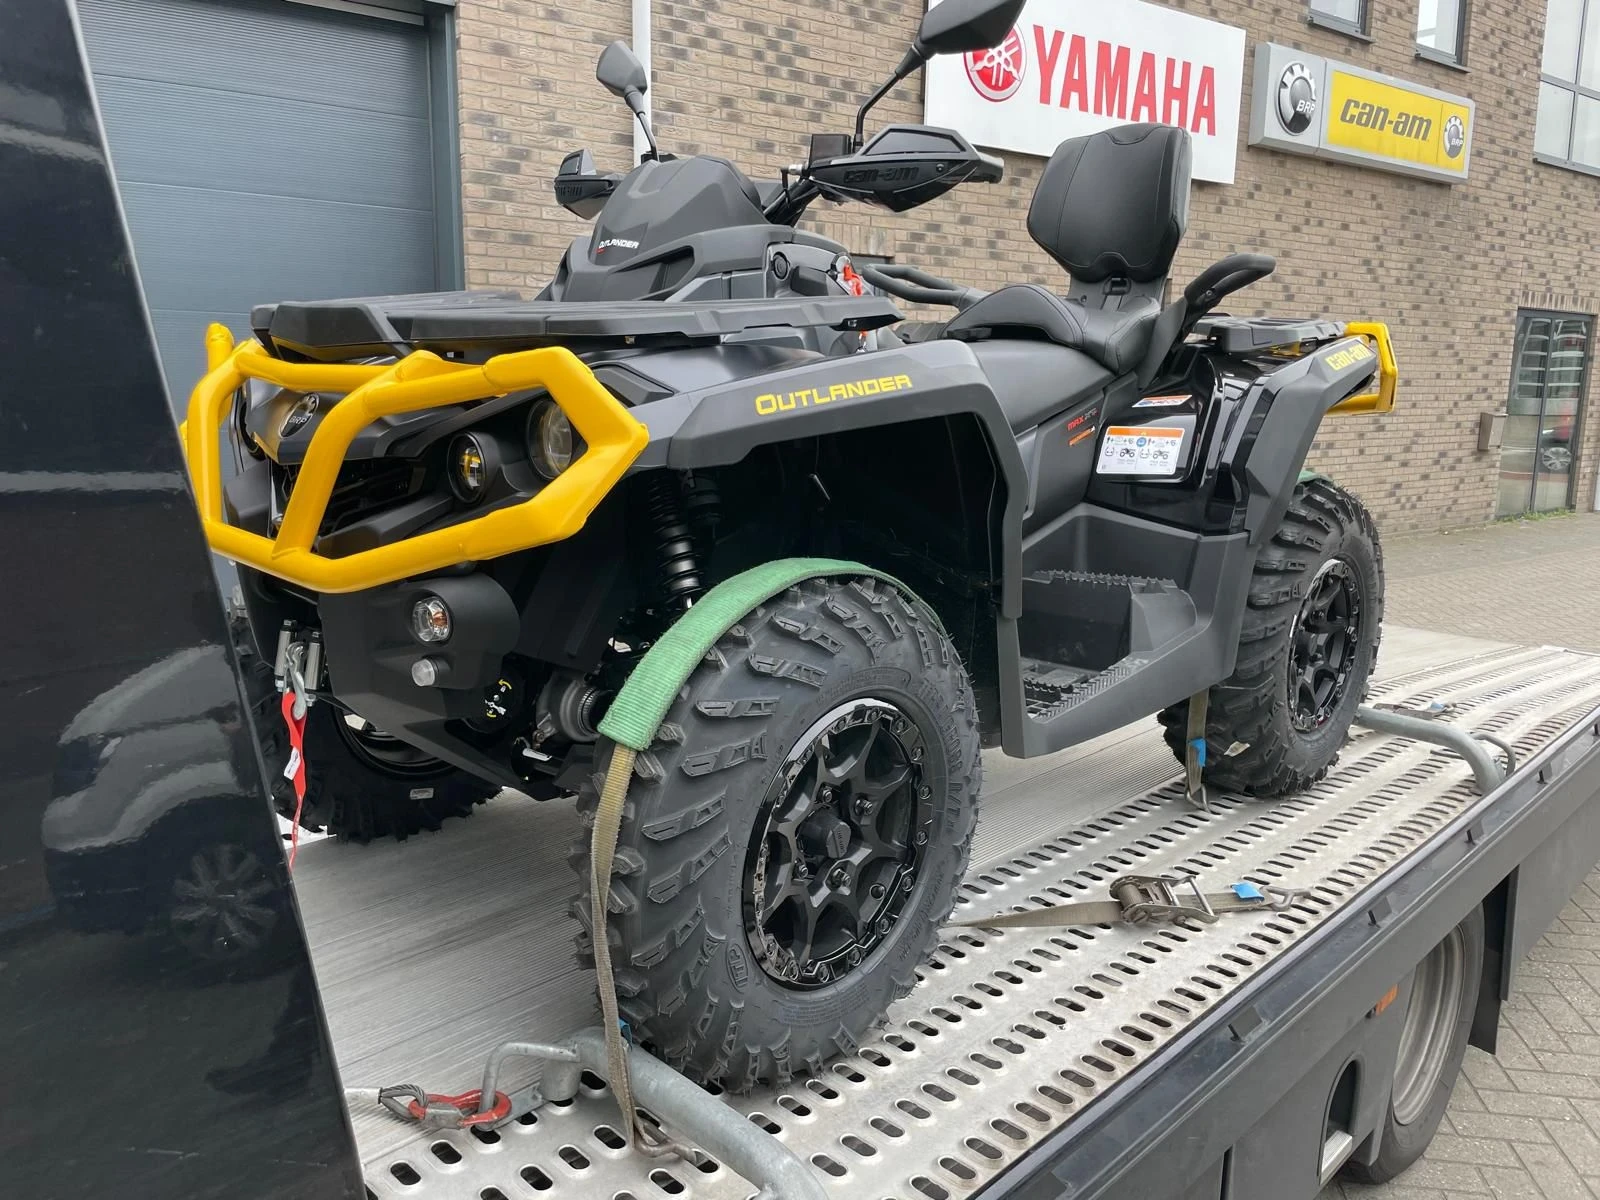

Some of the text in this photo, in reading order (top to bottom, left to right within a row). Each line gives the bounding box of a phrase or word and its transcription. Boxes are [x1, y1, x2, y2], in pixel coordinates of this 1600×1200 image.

[1032, 24, 1217, 136] YAMAHA
[1295, 100, 1316, 114] BRP
[1340, 97, 1432, 142] can-am
[1450, 138, 1464, 147] BRP
[755, 374, 913, 416] OUTLANDER
[288, 416, 307, 425] BRP
